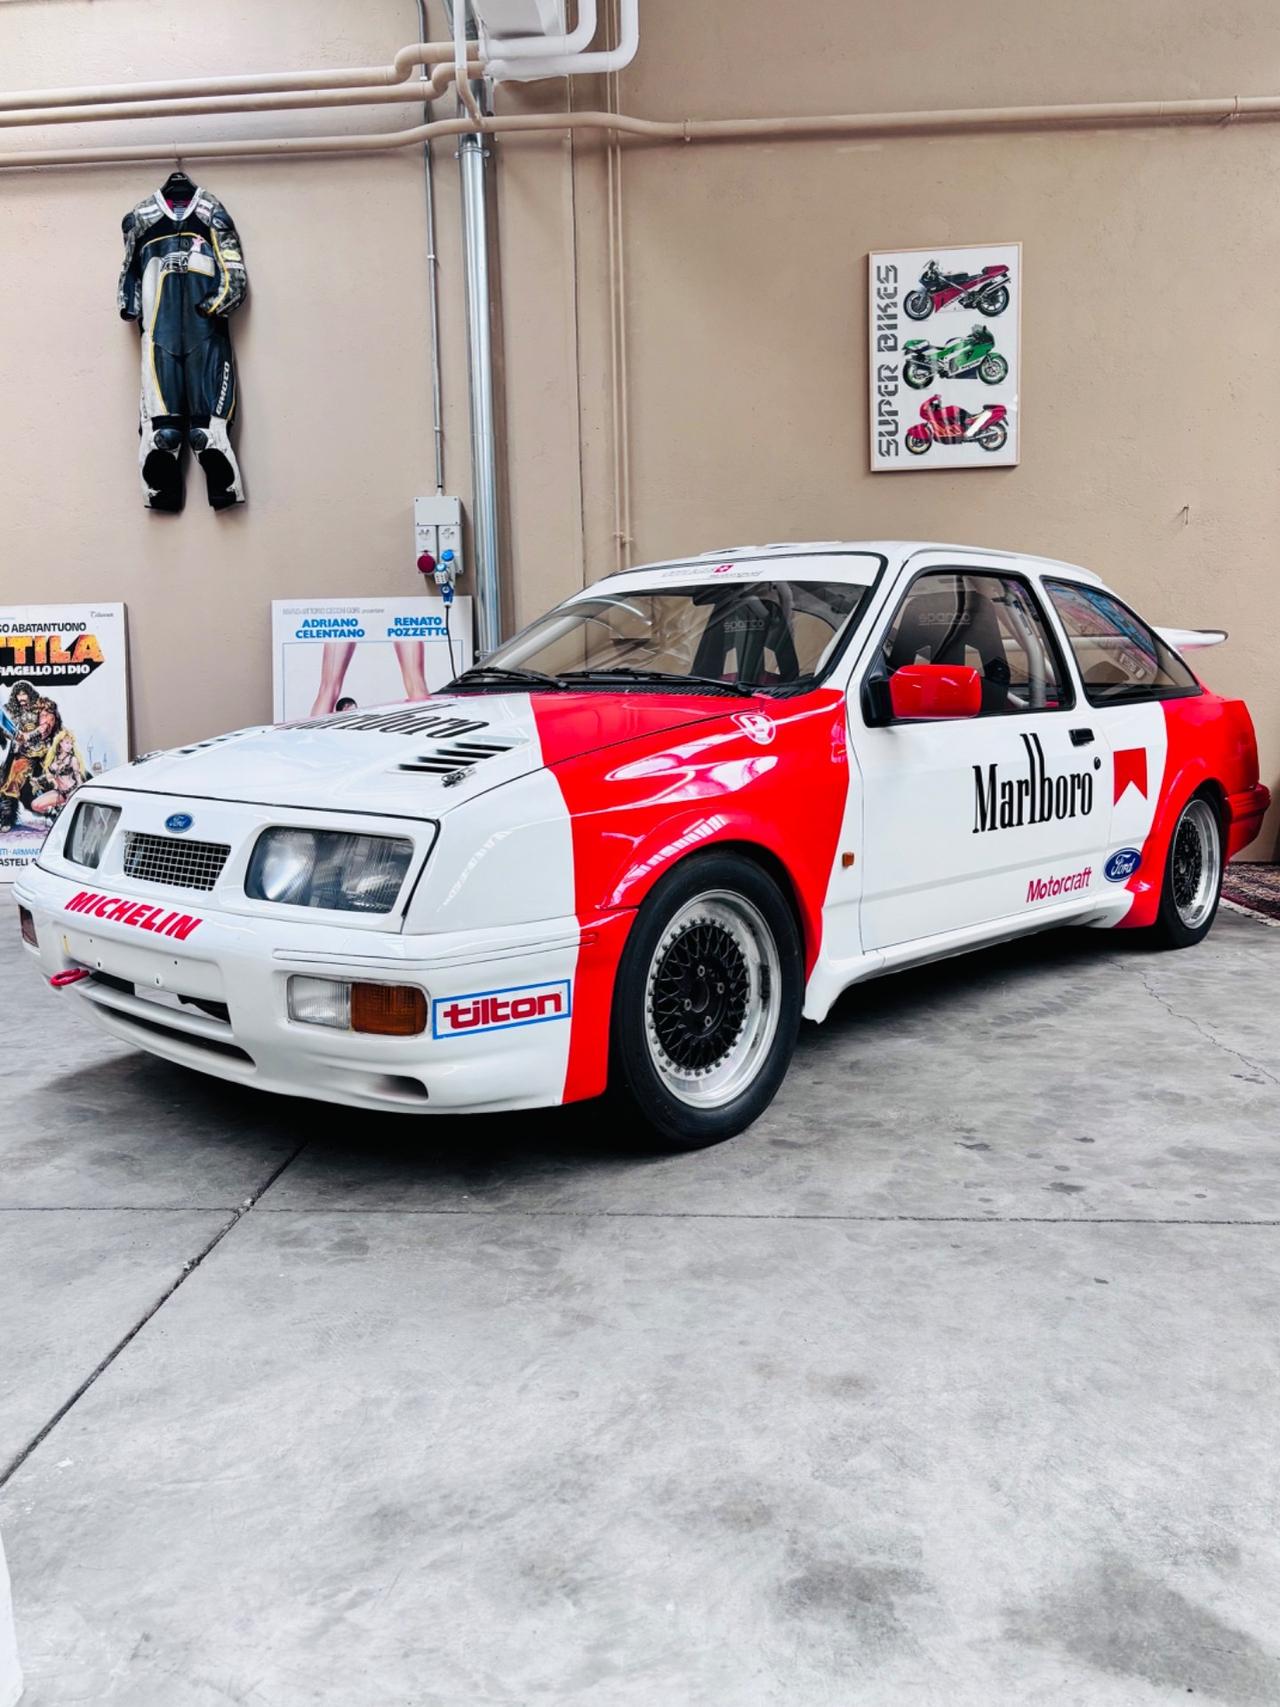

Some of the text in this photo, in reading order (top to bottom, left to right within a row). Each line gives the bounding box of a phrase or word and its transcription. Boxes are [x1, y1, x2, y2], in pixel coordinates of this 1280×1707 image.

[877, 265, 899, 457] SUPER BIKES
[11, 622, 87, 633] ABATANTUONO
[302, 618, 359, 628] ADRIANO
[394, 616, 443, 626] RENATO
[295, 628, 365, 639] CELENTANO
[387, 626, 449, 637] POZZETTO
[53, 665, 66, 675] DI
[67, 664, 90, 674] DIO
[972, 733, 1093, 834] Marlboro
[1111, 854, 1136, 876] Ford
[1025, 867, 1092, 903] Motorcraft
[64, 891, 204, 941] MICHELIN
[443, 992, 562, 1030] tilton
